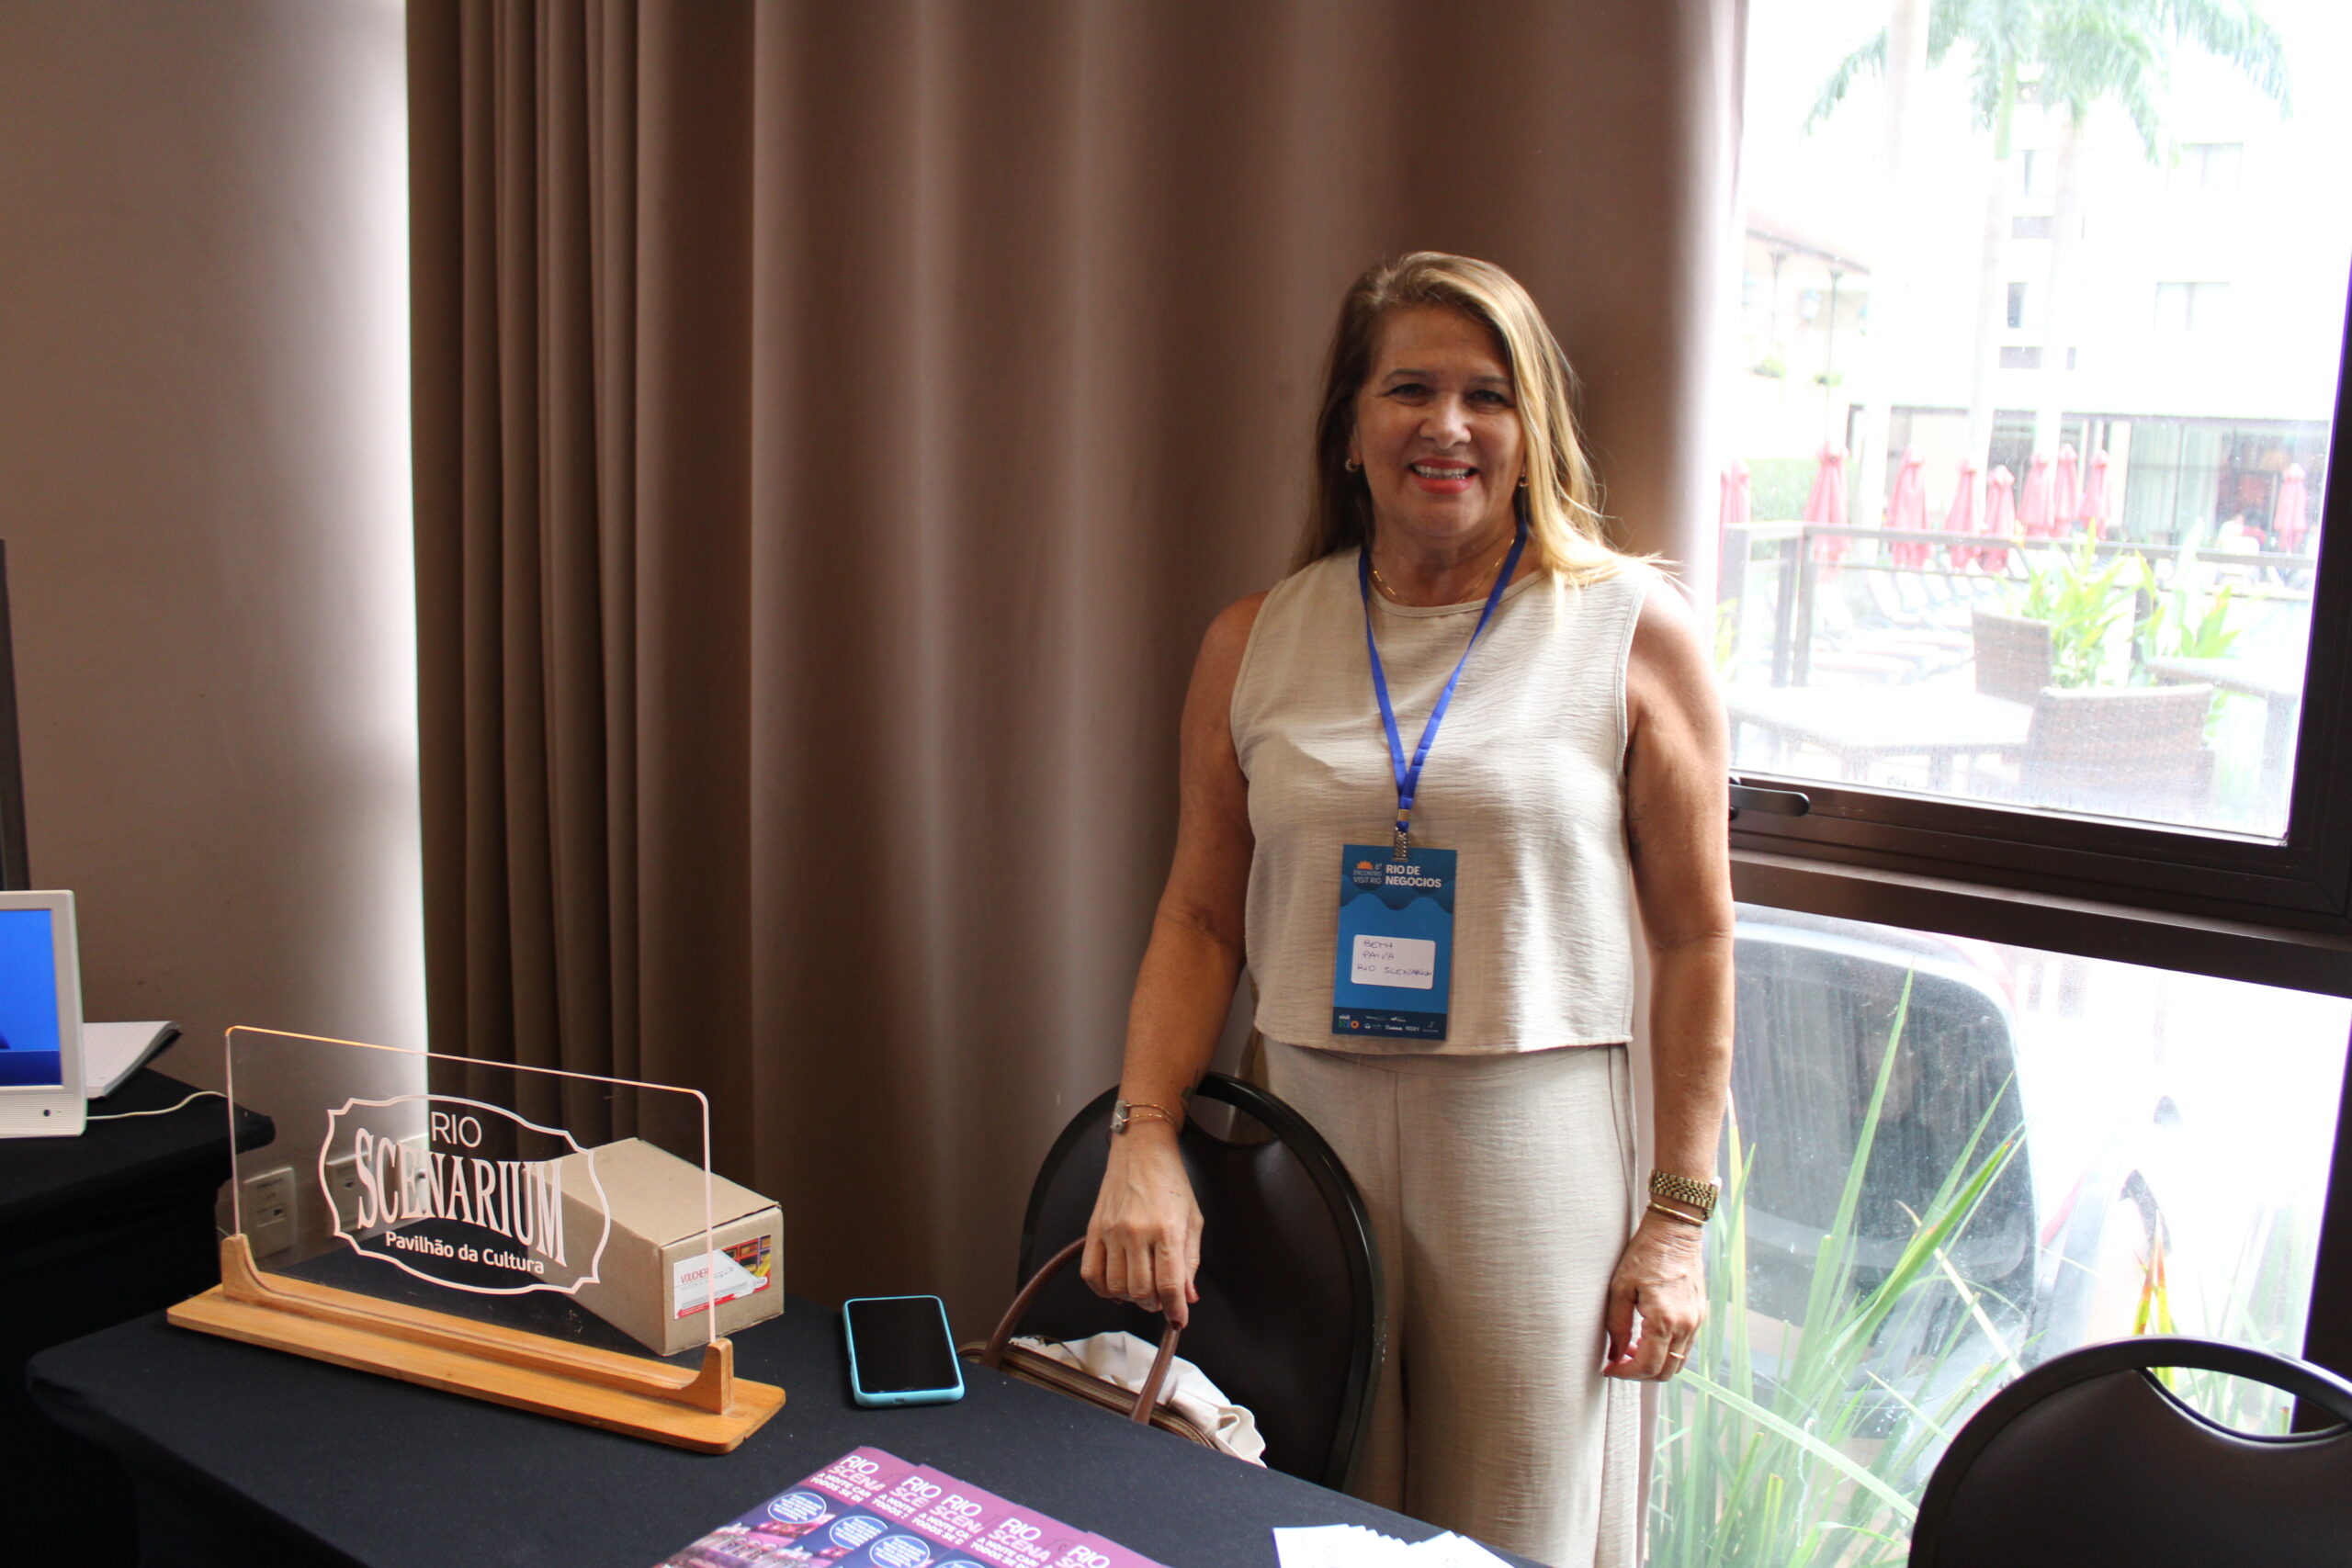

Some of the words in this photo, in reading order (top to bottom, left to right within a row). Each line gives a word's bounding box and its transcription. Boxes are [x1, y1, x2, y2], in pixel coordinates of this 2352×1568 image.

[1385, 864, 1405, 874] RIO
[1406, 865, 1420, 875] DE
[431, 1111, 482, 1148] RIO
[355, 1127, 568, 1268] SCENARIUM
[385, 1231, 454, 1258] Pavilhão
[458, 1243, 479, 1262] da
[482, 1247, 545, 1275] Cultura
[840, 1455, 879, 1474] RIO
[809, 1476, 841, 1492] TODOS
[838, 1487, 854, 1498] SE
[824, 1474, 854, 1490] NOITE
[901, 1475, 942, 1499] RIO
[872, 1497, 903, 1517] TODOS
[885, 1496, 917, 1515] NOITE
[941, 1494, 983, 1517] RIO
[911, 1517, 944, 1536] TODOS
[926, 1516, 956, 1533] NOITE
[999, 1517, 1042, 1540] RIO
[988, 1529, 1051, 1562] SCENA
[1067, 1544, 1110, 1568] RIO
